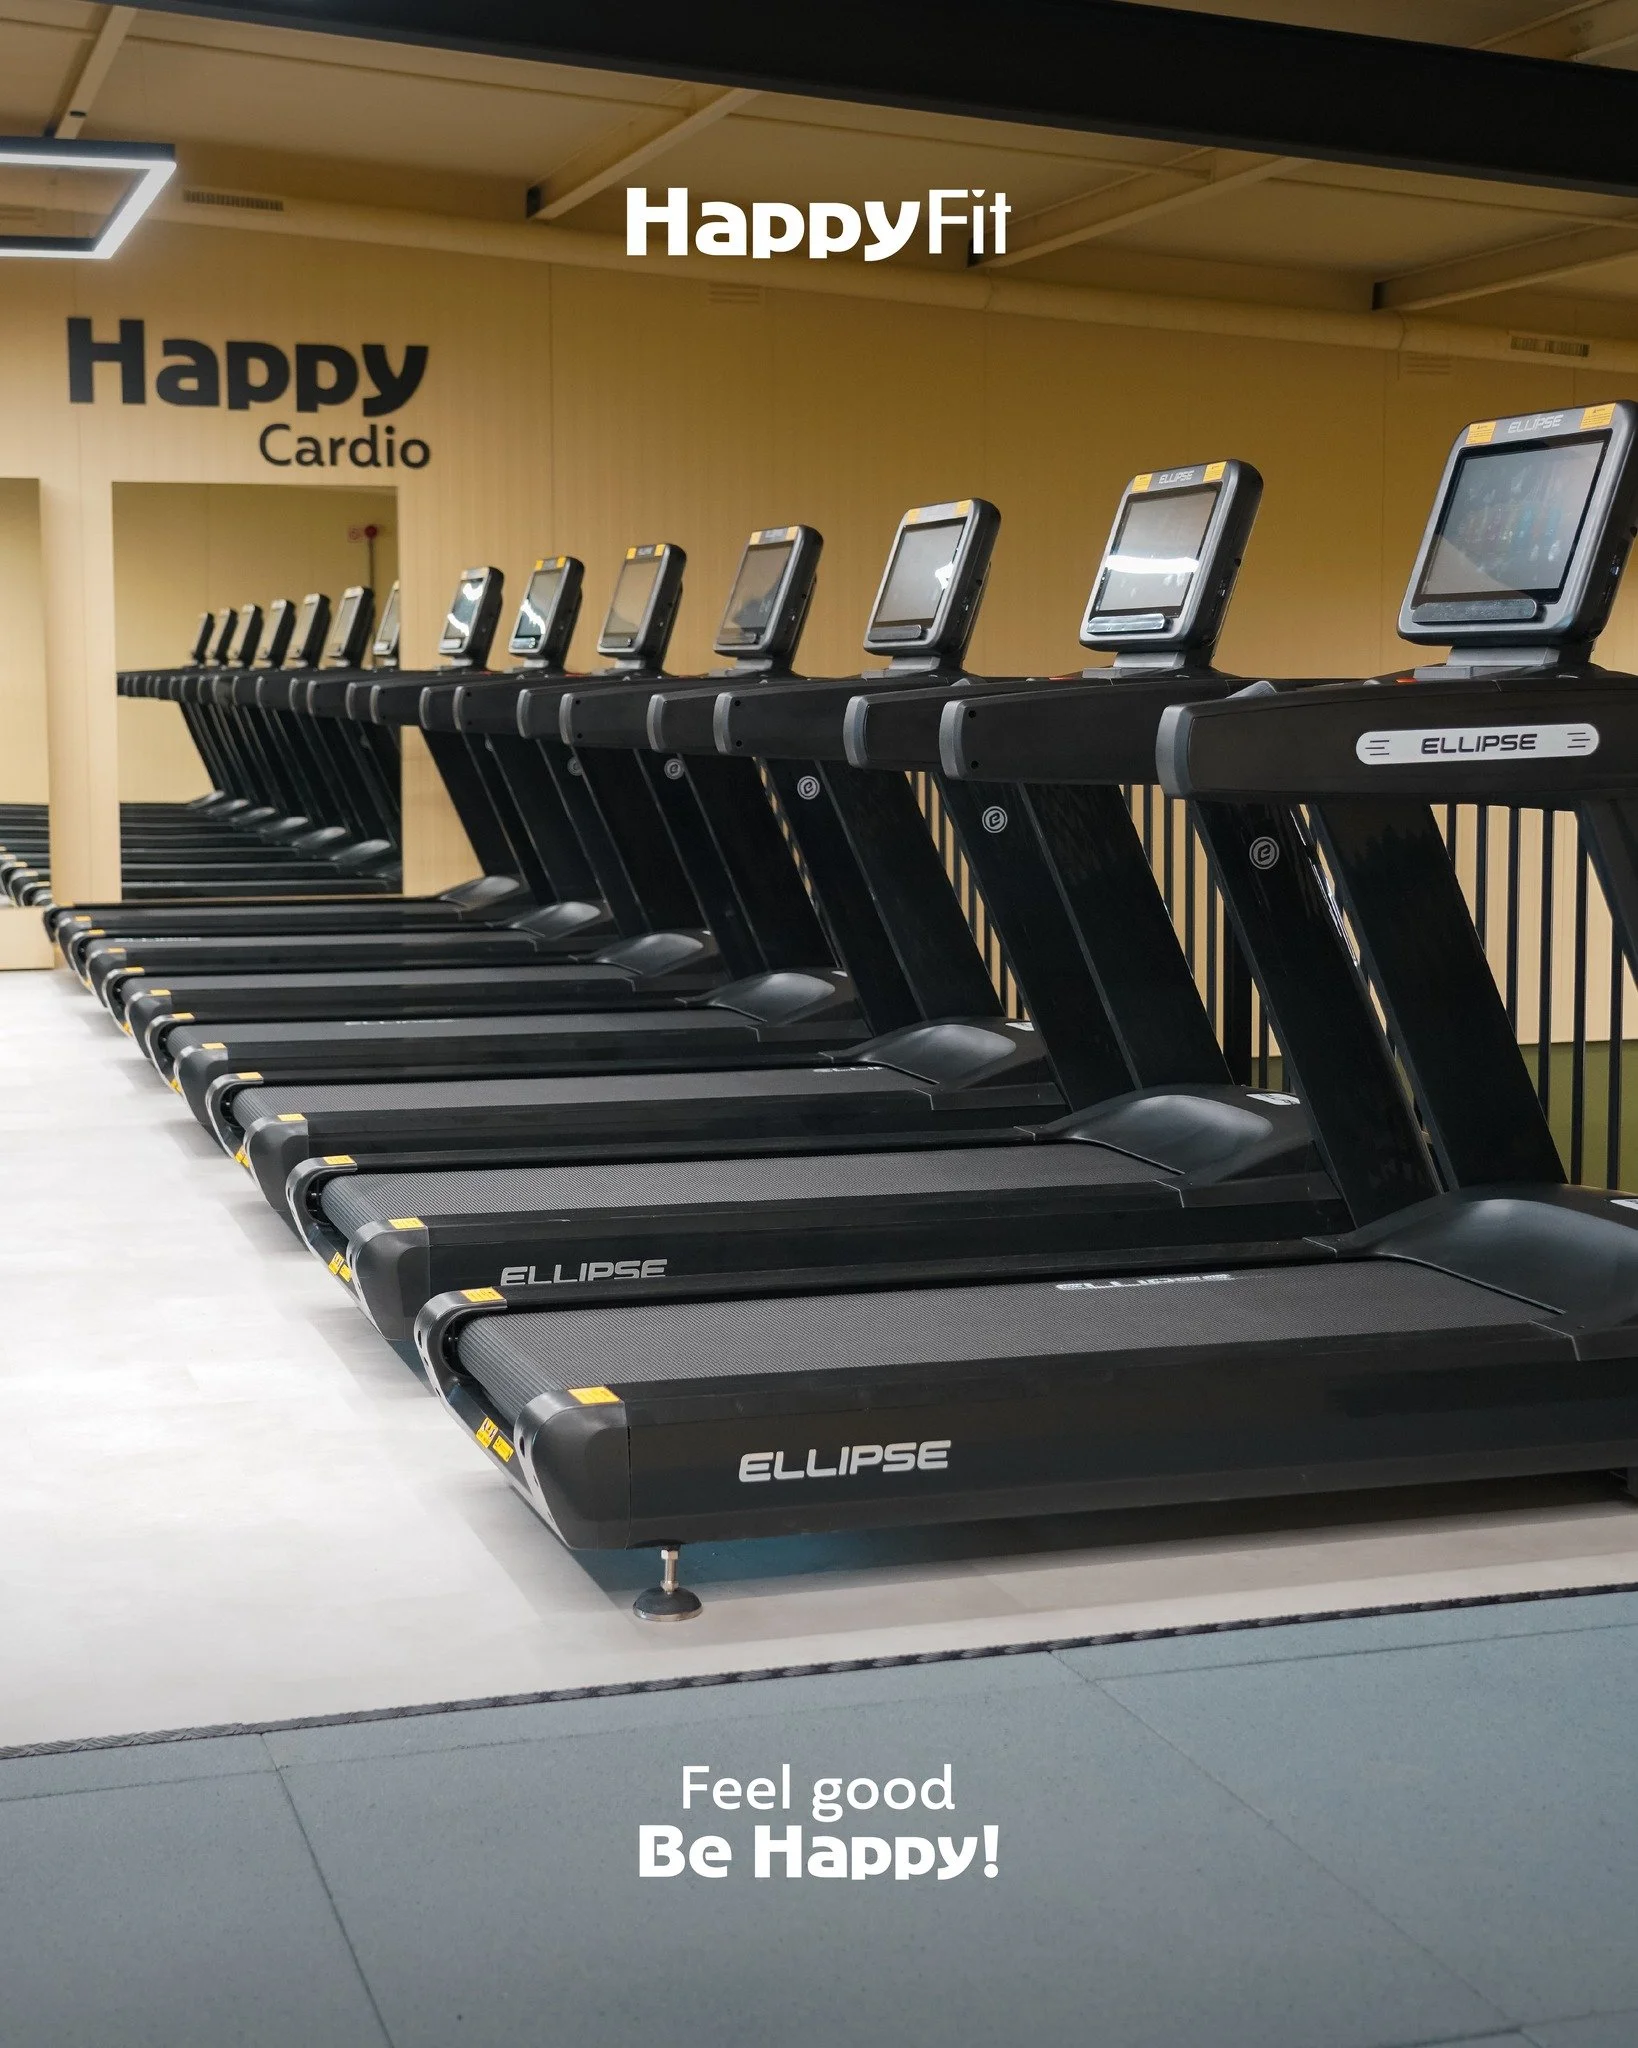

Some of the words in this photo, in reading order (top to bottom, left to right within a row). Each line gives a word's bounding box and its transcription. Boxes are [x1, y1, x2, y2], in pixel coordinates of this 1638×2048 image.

[67, 316, 429, 417] Happy
[1508, 414, 1564, 434] ELLIPSE
[259, 423, 431, 469] Cardio
[1420, 733, 1538, 754] ELLIPSE
[500, 1258, 667, 1287] ELLIPSE
[738, 1439, 952, 1483] ELLIPSE
